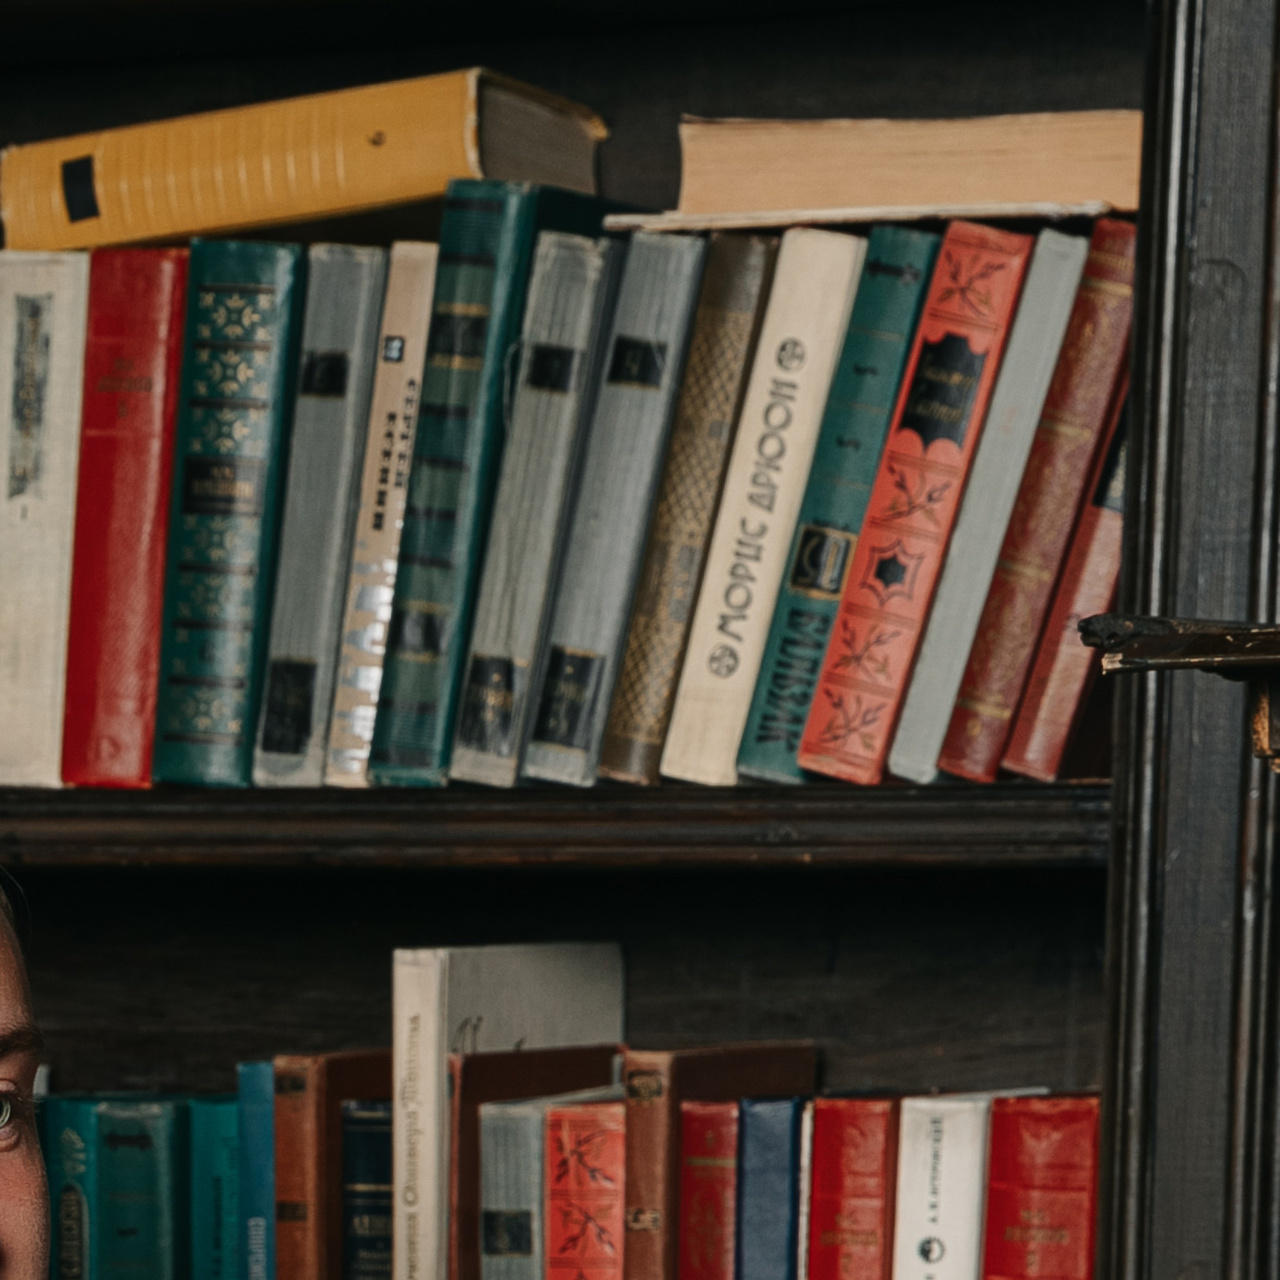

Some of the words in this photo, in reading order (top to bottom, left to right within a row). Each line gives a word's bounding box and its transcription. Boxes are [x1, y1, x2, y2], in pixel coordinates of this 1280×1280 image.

[717, 518, 768, 644] МОРИС
[755, 376, 801, 514] ДРЮОН
[757, 607, 832, 752] БАЛЬЗАК
